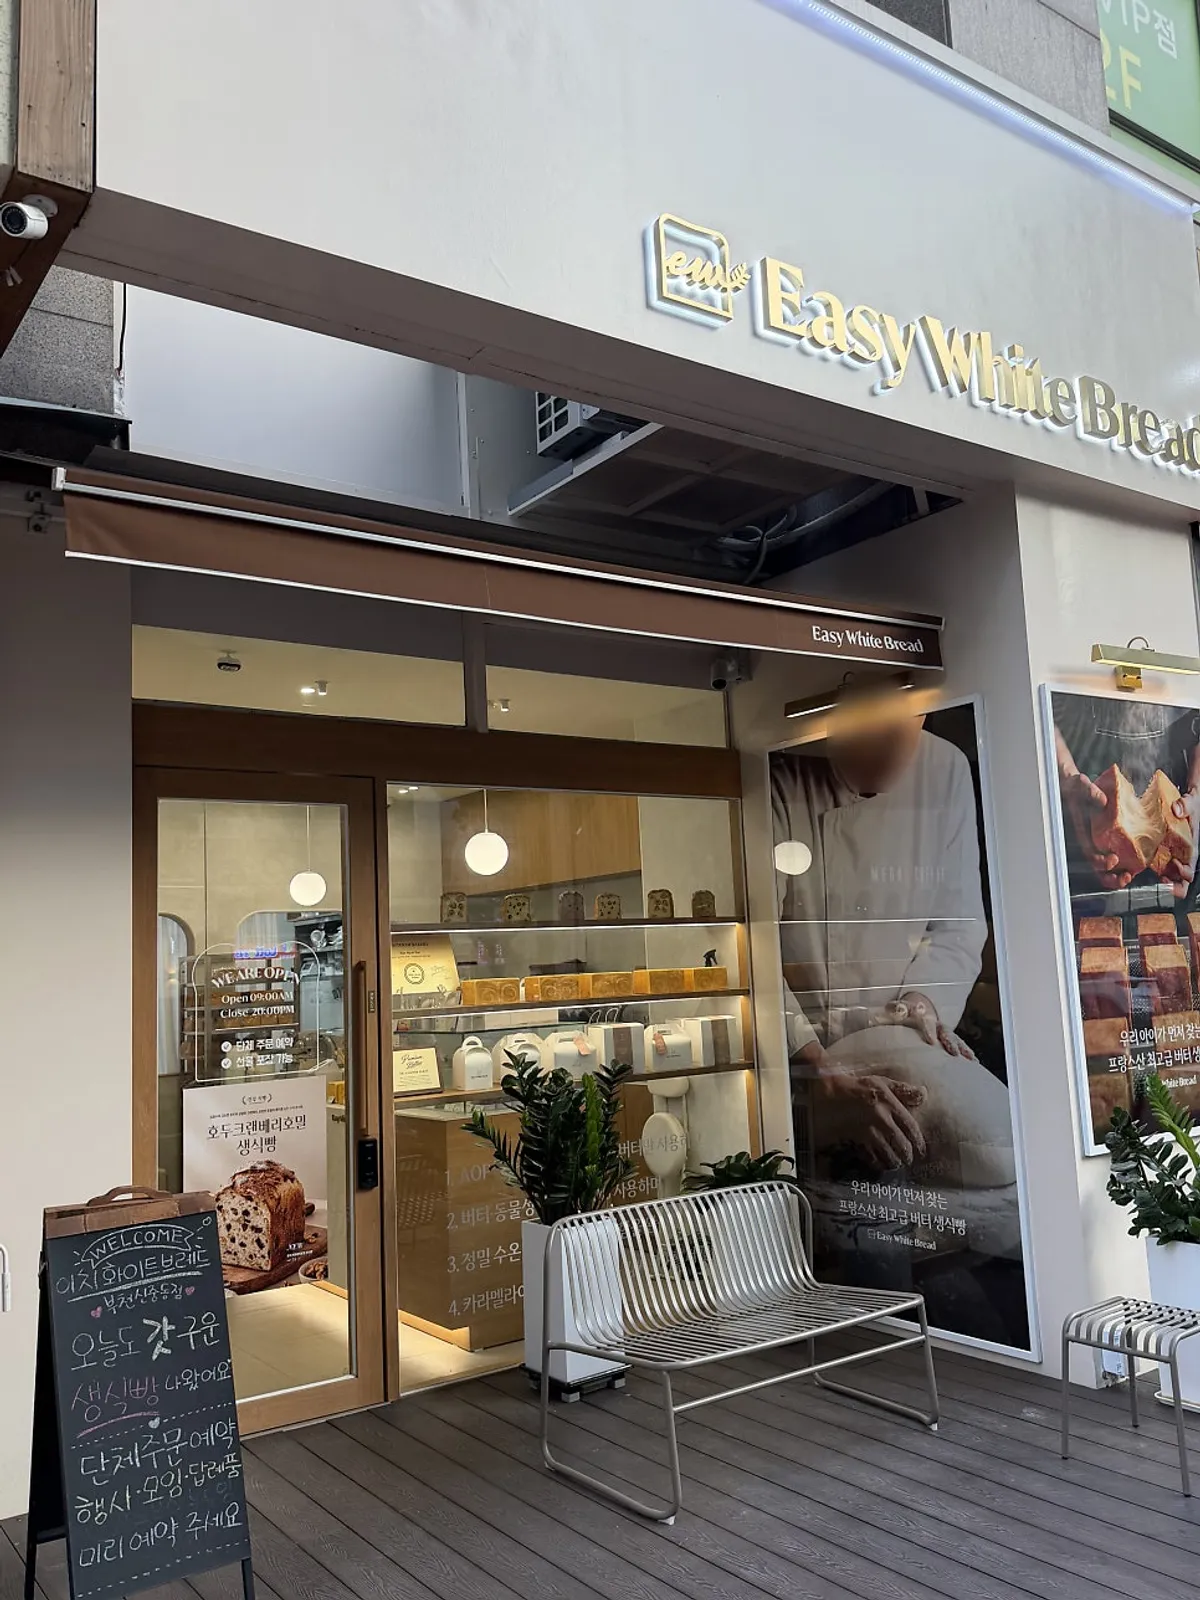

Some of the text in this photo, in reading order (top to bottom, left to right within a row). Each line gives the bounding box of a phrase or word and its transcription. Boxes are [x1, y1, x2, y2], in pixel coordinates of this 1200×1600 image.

[757, 256, 916, 389] Easy
[917, 314, 1077, 428] White
[812, 625, 924, 653] Easy White Bread
[211, 971, 234, 988] WE
[236, 966, 262, 981] ARE
[221, 991, 294, 1005] Open 09:00AM
[220, 1005, 295, 1018] Close 20:00PM
[256, 1038, 274, 1050] 주문
[1119, 1028, 1139, 1047] 우리
[1139, 1026, 1166, 1044] 아이가
[1168, 1024, 1185, 1042] 먼저
[1108, 1052, 1145, 1073] 프랑스산
[1147, 1049, 1173, 1069] 최고급
[1174, 1046, 1192, 1064] 버터
[1179, 1075, 1197, 1087] Bread
[236, 1135, 277, 1156] 생식빵
[850, 1180, 948, 1210] 우리 아이가 먼저 찾는
[839, 1200, 967, 1236] 프랑스산 최고급 버터 생식빵
[89, 1228, 184, 1260] WELCOME
[876, 1231, 937, 1250] Easy White Bread
[447, 1255, 460, 1273] 3.
[104, 1282, 183, 1314] 부천신중동점
[448, 1300, 460, 1318] 4.
[71, 1312, 220, 1371] 오늘도 갓 구운
[71, 1361, 232, 1423] 생식빵 나왔어요
[79, 1502, 243, 1567] 미리 예약 주세요
